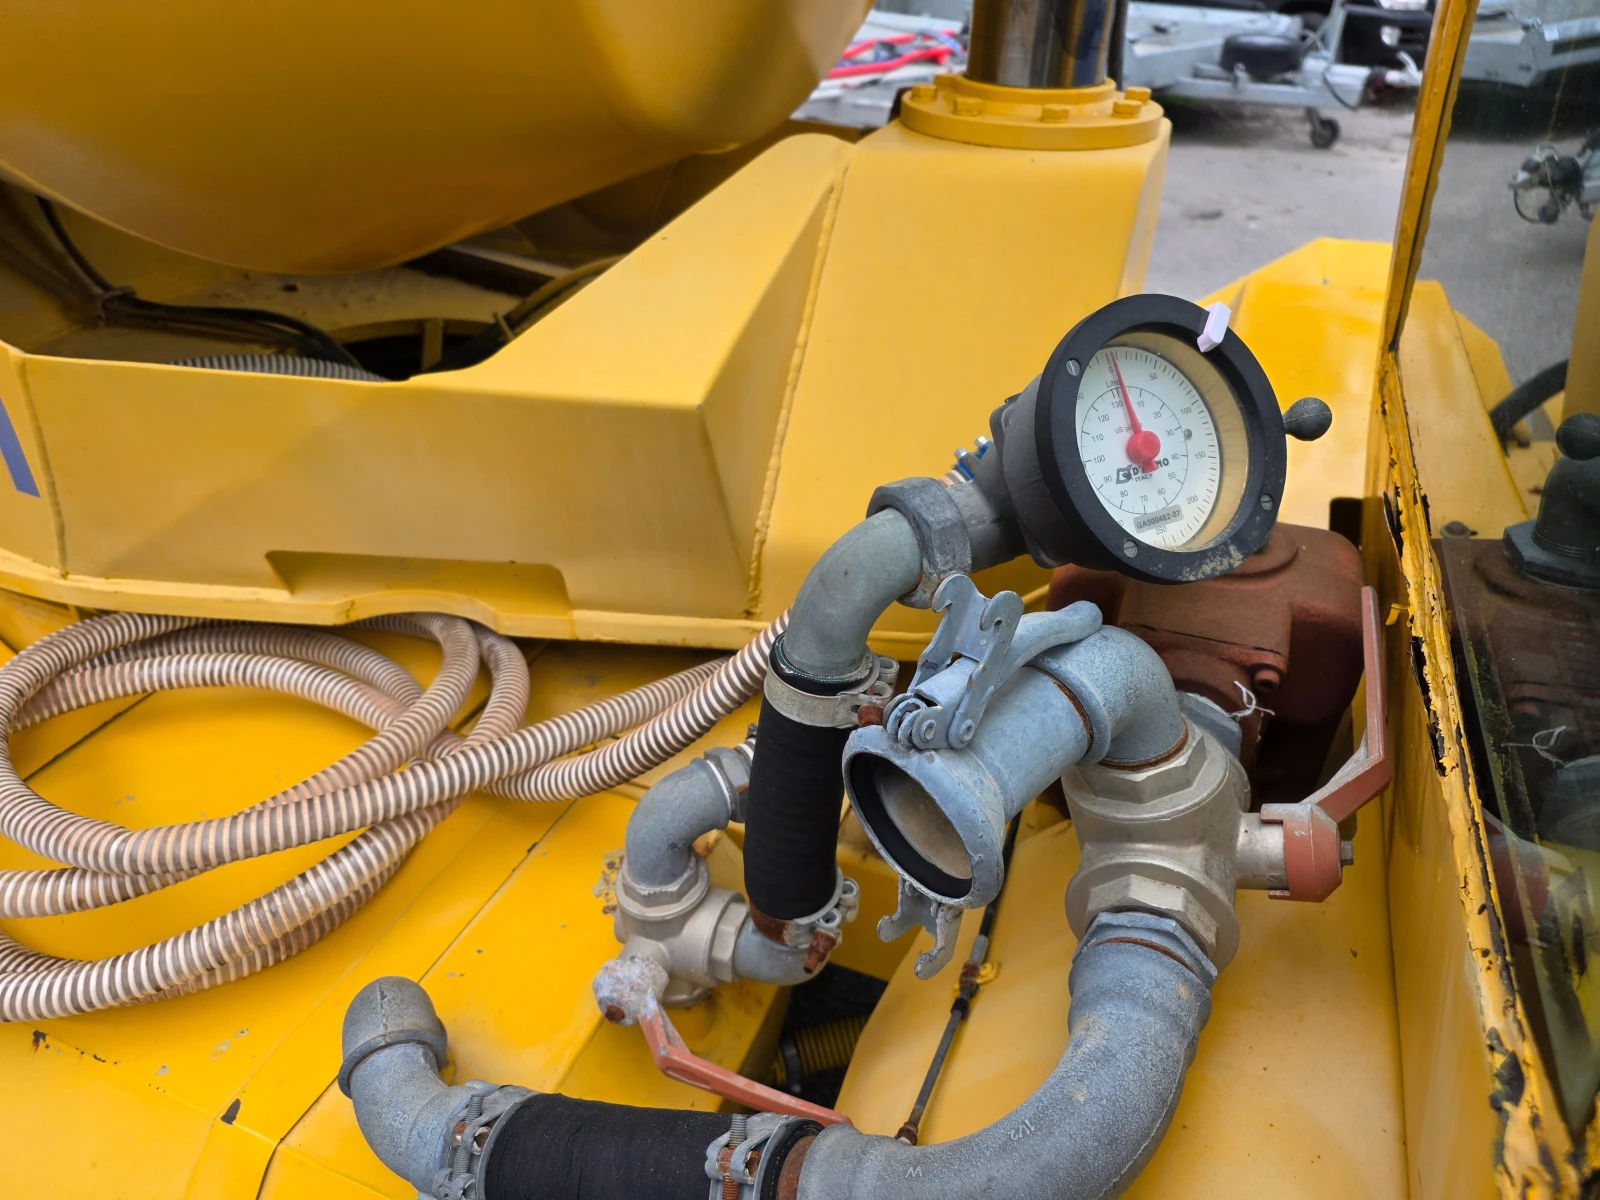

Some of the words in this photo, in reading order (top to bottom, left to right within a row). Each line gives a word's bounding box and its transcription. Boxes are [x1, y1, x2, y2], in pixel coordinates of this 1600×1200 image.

[1150, 373, 1158, 381] 50
[1106, 379, 1121, 388] Litre
[1111, 400, 1123, 409] 130
[1137, 400, 1145, 408] 10
[1153, 411, 1162, 419] 20
[1180, 407, 1192, 415] 100
[1098, 414, 1110, 423] 120
[1114, 426, 1123, 434] US
[1166, 428, 1174, 437] 30
[1092, 433, 1104, 442] 110
[1093, 455, 1106, 464] 100
[1171, 452, 1180, 460] 40
[1194, 451, 1206, 460] 150
[1103, 475, 1113, 484] 90
[1135, 472, 1153, 483] ITALY
[1168, 472, 1176, 481] 50
[1120, 489, 1129, 498] 80
[1157, 487, 1166, 496] 60
[1140, 495, 1149, 503] 70
[1187, 495, 1199, 504] 200
[1155, 526, 1167, 535] 250
